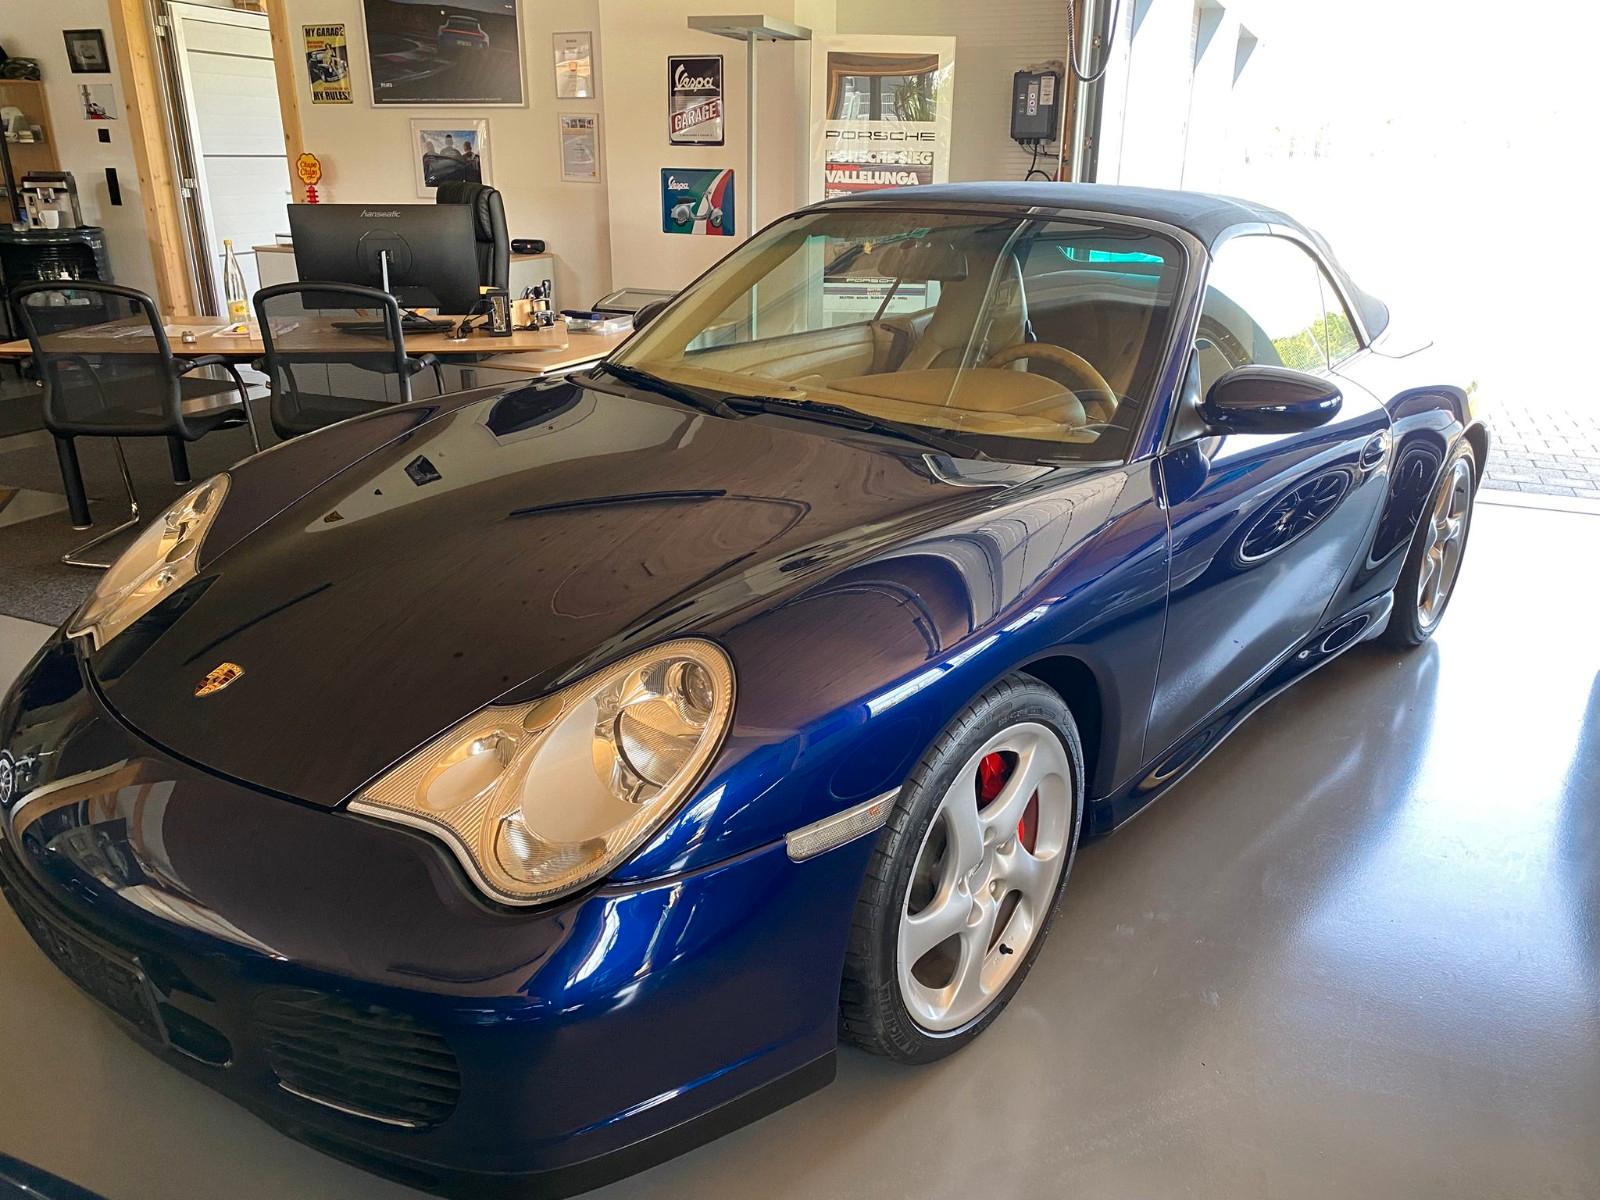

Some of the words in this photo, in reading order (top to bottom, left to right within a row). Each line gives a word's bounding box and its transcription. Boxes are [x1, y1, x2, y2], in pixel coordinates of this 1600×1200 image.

[304, 28, 316, 37] MY
[674, 64, 720, 92] Vespa
[313, 91, 324, 101] MY
[674, 102, 717, 131] GARAGE
[825, 130, 936, 141] PORSCHE
[668, 176, 689, 190] Vespa
[825, 170, 919, 185] VALLELUNGA
[360, 209, 400, 218] hanseatic
